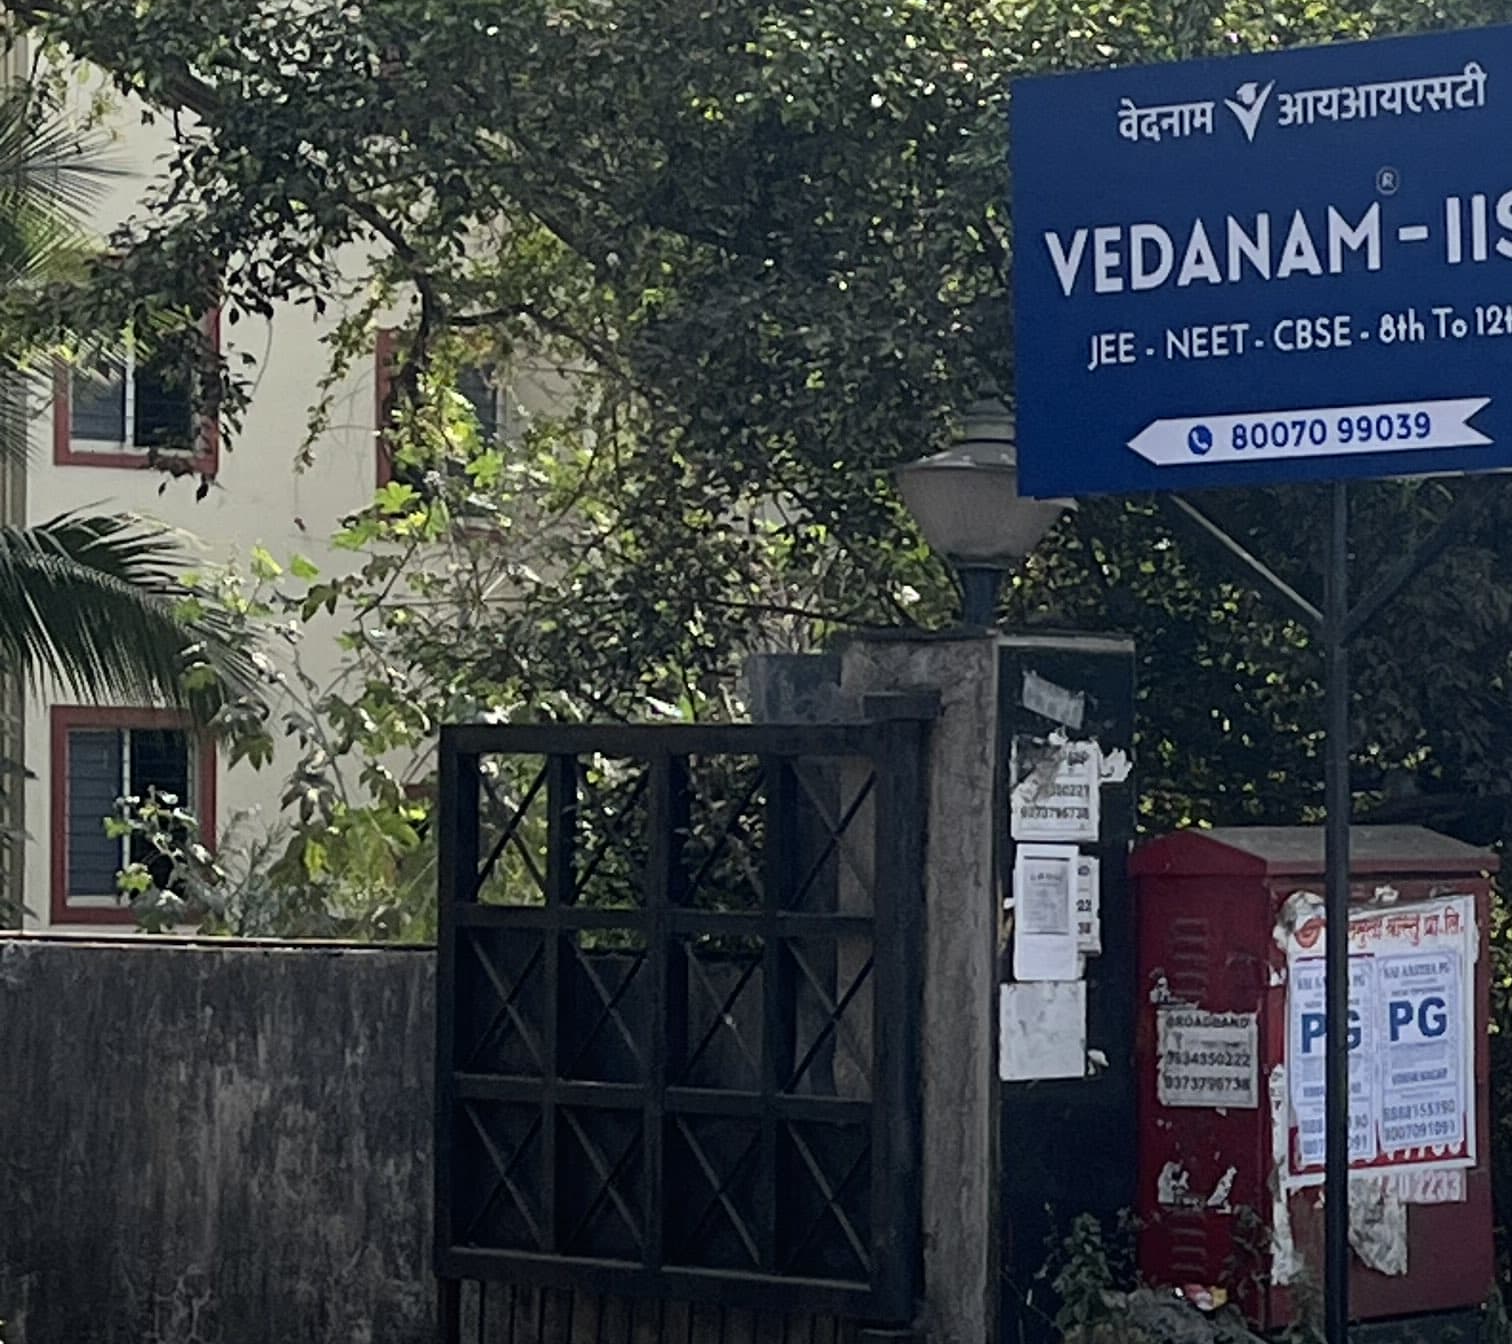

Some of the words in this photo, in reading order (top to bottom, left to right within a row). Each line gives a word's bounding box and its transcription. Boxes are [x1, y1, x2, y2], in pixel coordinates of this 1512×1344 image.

[1118, 98, 1215, 142] वेदनाम
[1278, 62, 1487, 126] आयआयएसटी
[1045, 202, 1381, 296] VEDANAM
[1087, 332, 1136, 371] JEE
[1167, 323, 1249, 359] NEET
[1274, 316, 1352, 351] CBSE
[1379, 308, 1425, 343] 8th
[1432, 307, 1467, 339] To
[1231, 418, 1328, 451] 80070
[1337, 411, 1431, 444] 99039
[1389, 996, 1447, 1042] PG
